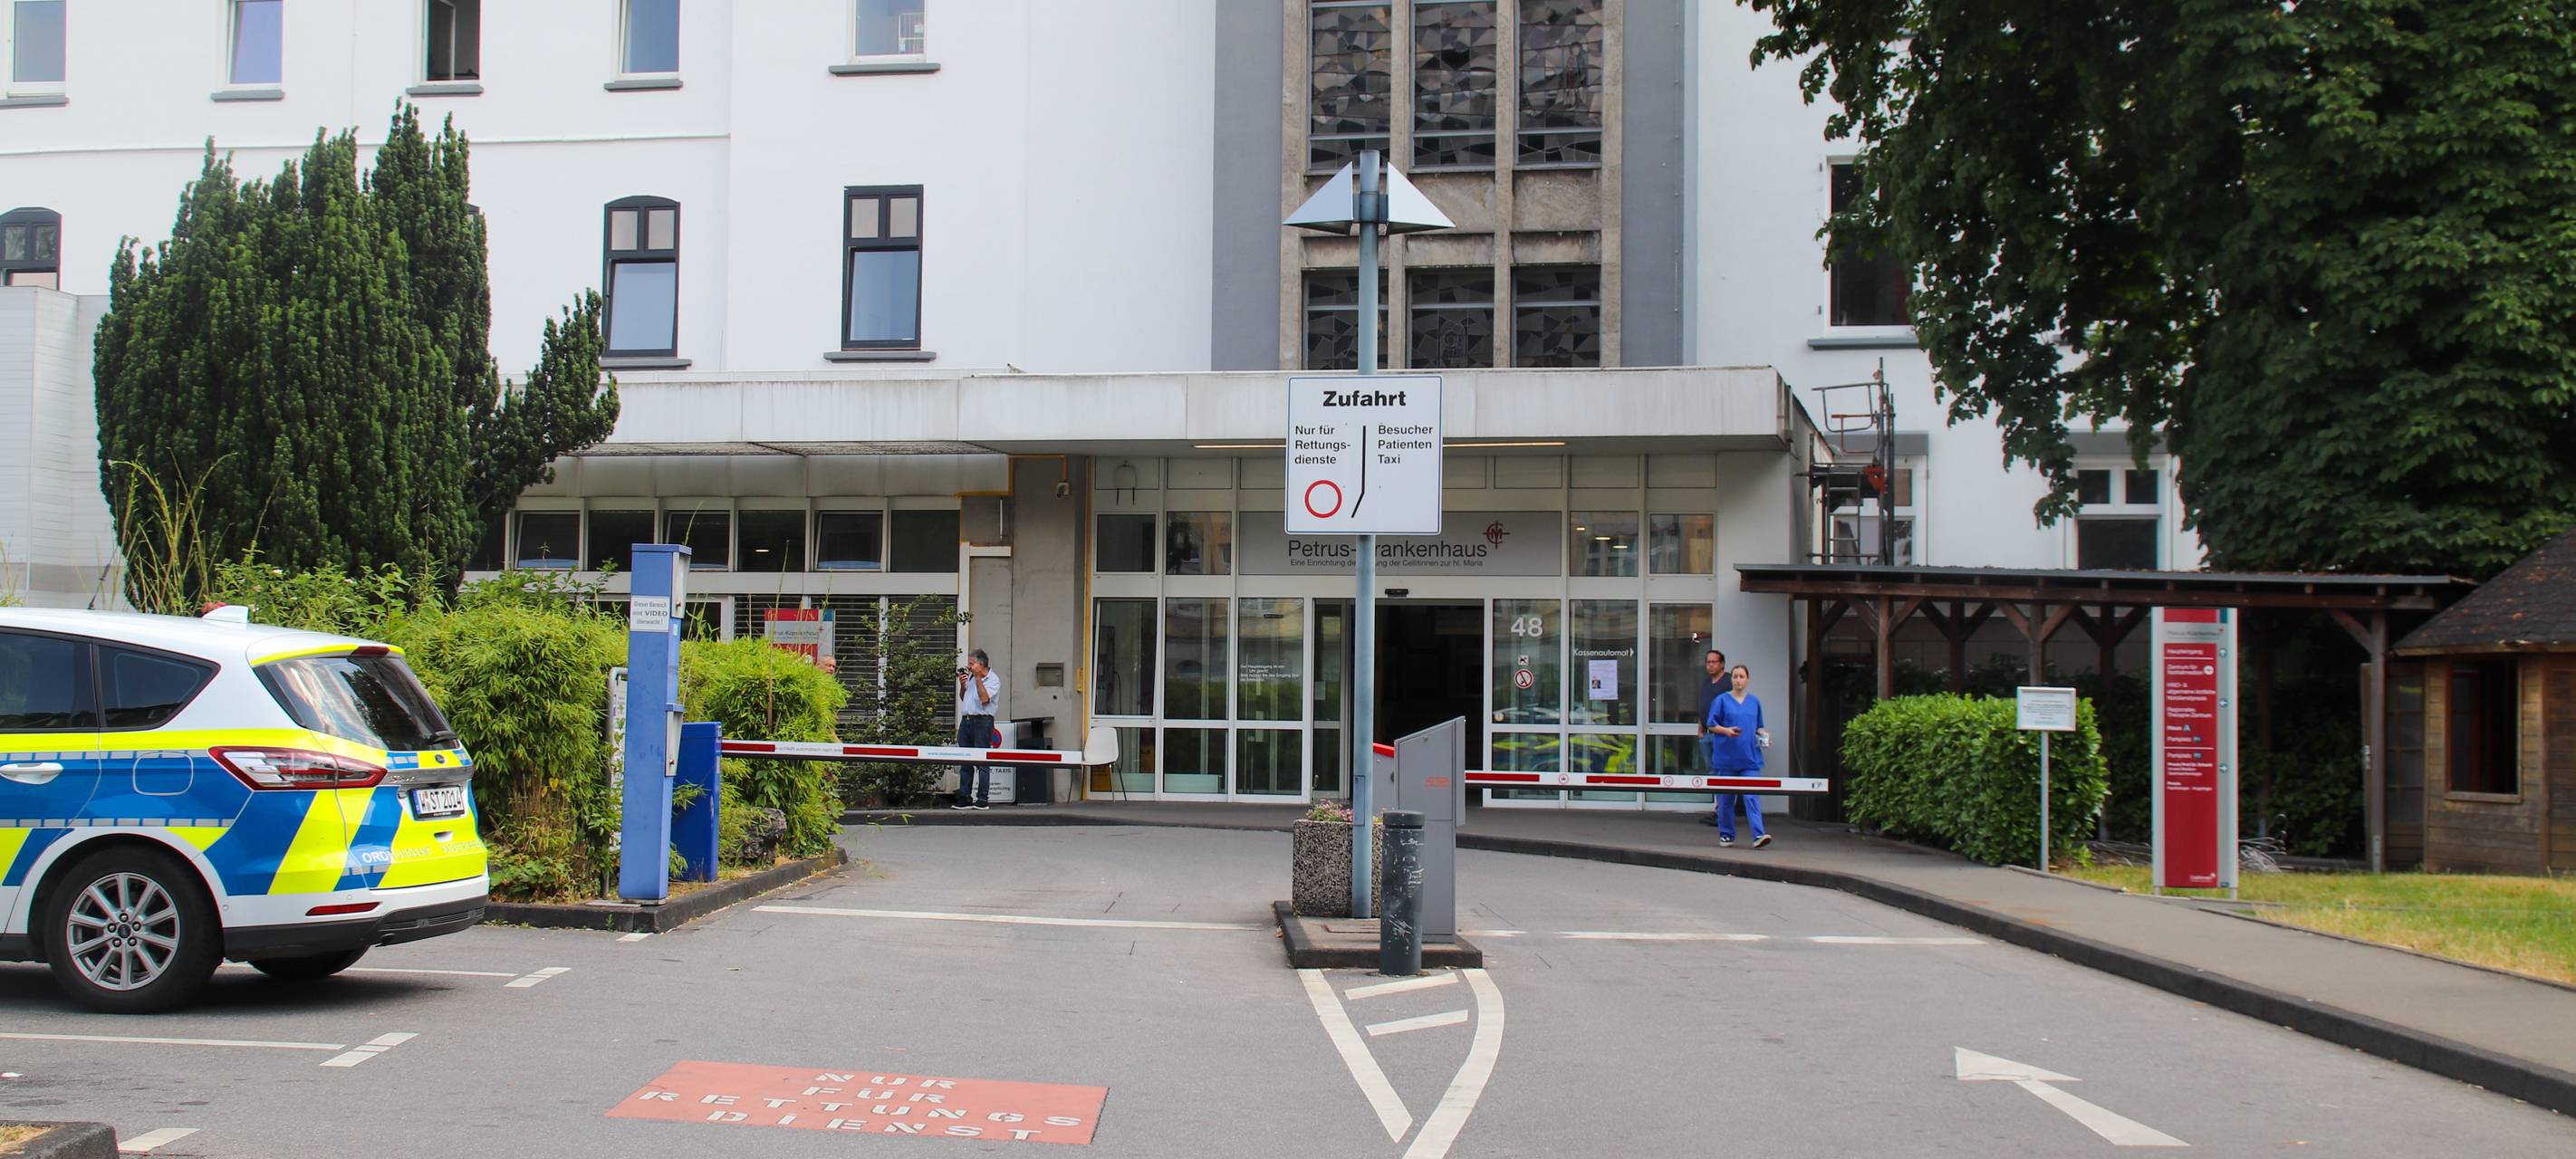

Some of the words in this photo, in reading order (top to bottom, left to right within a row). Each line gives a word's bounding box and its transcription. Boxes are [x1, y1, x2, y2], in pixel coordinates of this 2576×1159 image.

[1322, 390, 1407, 407] Zufahrt
[1295, 426, 1315, 435] Nur
[1319, 425, 1335, 435] für
[1378, 425, 1433, 435] Besucher
[1295, 440, 1350, 452] Rettungs-
[1378, 439, 1432, 449] Patienten
[1294, 455, 1337, 465] dienste
[1378, 454, 1401, 464] Taxi
[1289, 540, 1486, 557] Petrus-rankenhaus
[1307, 559, 1345, 567] Einrichtung
[1510, 617, 1543, 637] 48
[1572, 647, 1629, 656] Kassenautomat
[430, 790, 441, 810] ST
[442, 789, 462, 809] 2014
[814, 1072, 957, 1090] NUR
[639, 1091, 1081, 1127] RETTUNGS
[706, 1110, 1042, 1140] DIENST
